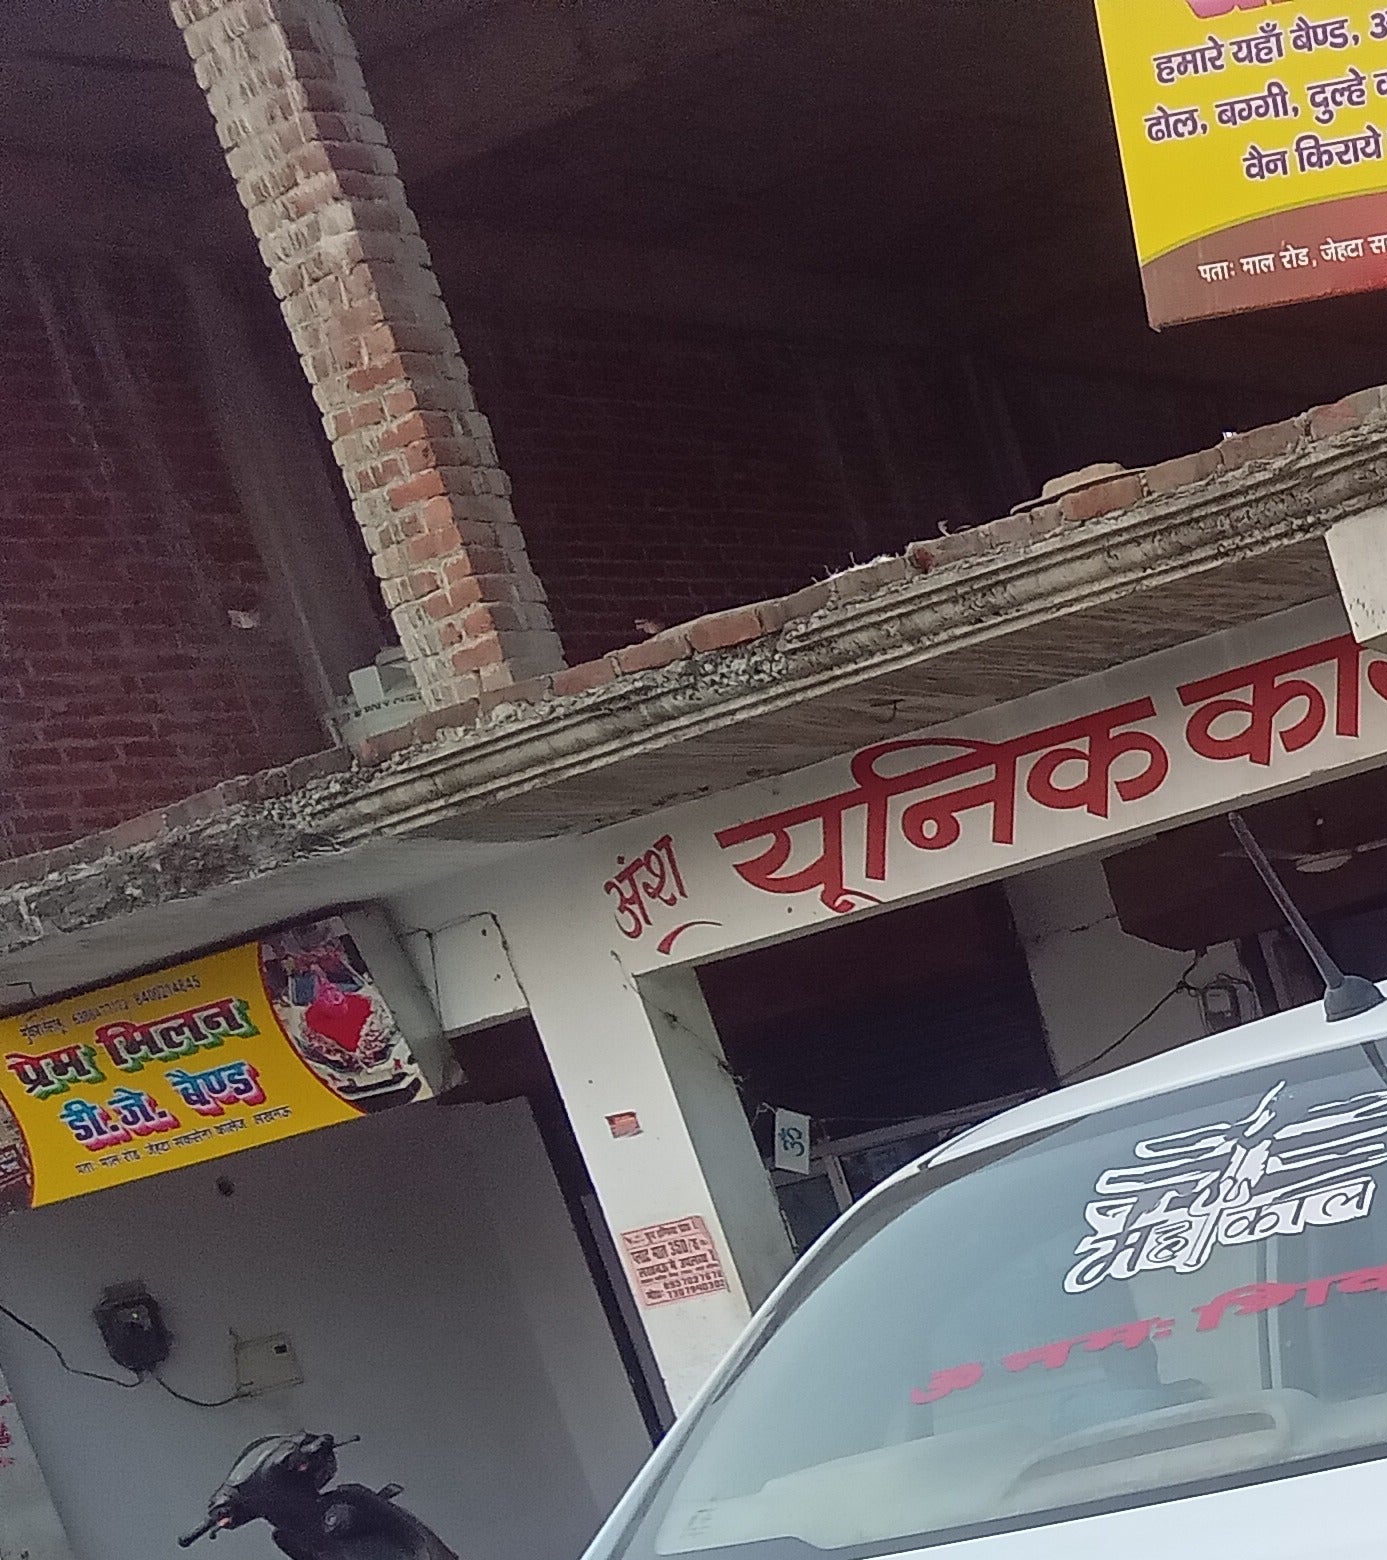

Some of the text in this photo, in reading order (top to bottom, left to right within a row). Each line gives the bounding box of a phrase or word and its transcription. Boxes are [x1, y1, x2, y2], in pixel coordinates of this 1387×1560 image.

[1153, 35, 1225, 83] हमारे
[1230, 23, 1284, 64] यहाँ
[1290, 17, 1359, 52] बैण्ड,
[1144, 105, 1208, 141] ढोल,
[1215, 81, 1299, 126] बग्गी,
[1307, 67, 1366, 123] दुल्हे
[1243, 145, 1288, 180] वैन
[1294, 124, 1382, 173] किराये
[1239, 252, 1275, 274] माल
[1320, 238, 1365, 263] जेहटा
[716, 698, 1171, 913] यूनिक
[604, 834, 688, 939] अंश
[5, 1044, 100, 1096] प्रेम
[95, 998, 252, 1069] मिलन
